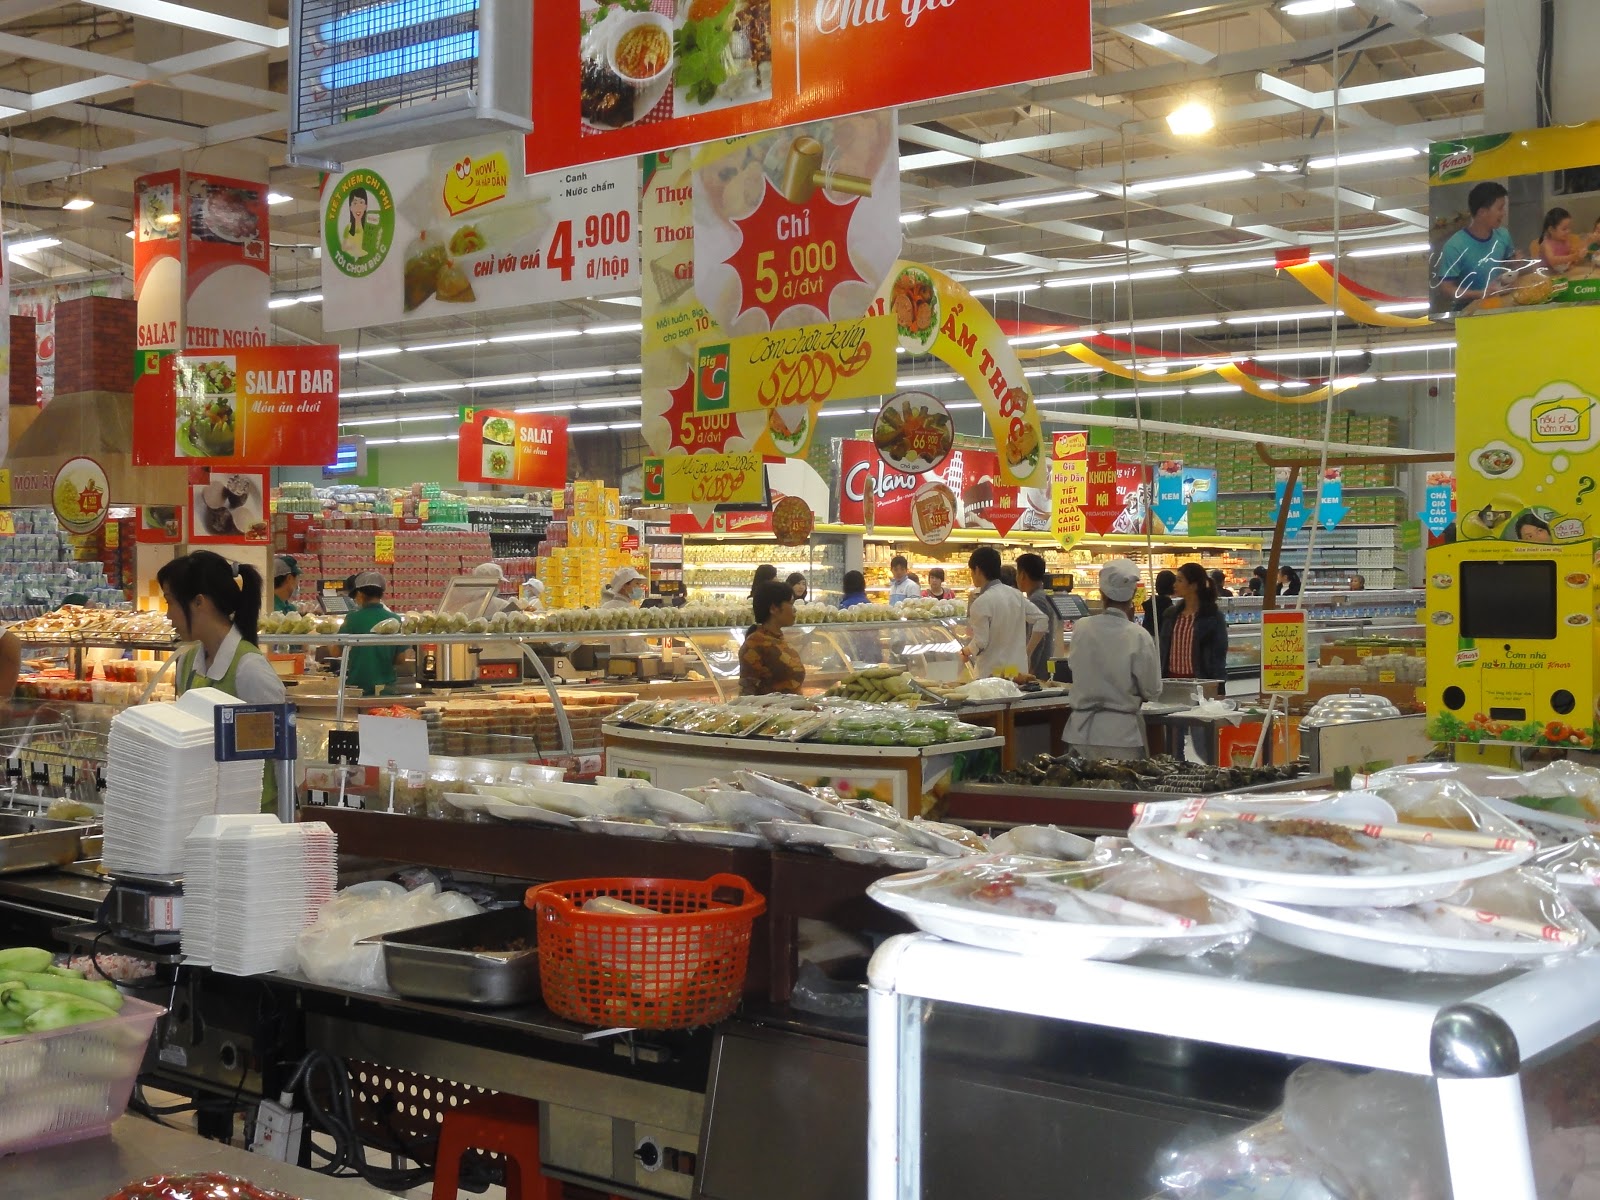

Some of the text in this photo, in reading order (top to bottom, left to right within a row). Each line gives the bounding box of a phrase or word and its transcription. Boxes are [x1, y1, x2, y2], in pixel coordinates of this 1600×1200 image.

[475, 160, 496, 176] WOW!
[565, 172, 588, 183] Canh
[137, 320, 177, 347] SALAT
[663, 332, 677, 343] cho
[695, 315, 709, 332] 10
[699, 355, 717, 369] Big
[245, 369, 334, 395] SALAT BAR
[520, 427, 553, 445] SALAT
[645, 464, 656, 474] Big
[845, 458, 917, 503] Clano
[1161, 492, 1180, 501] KEM
